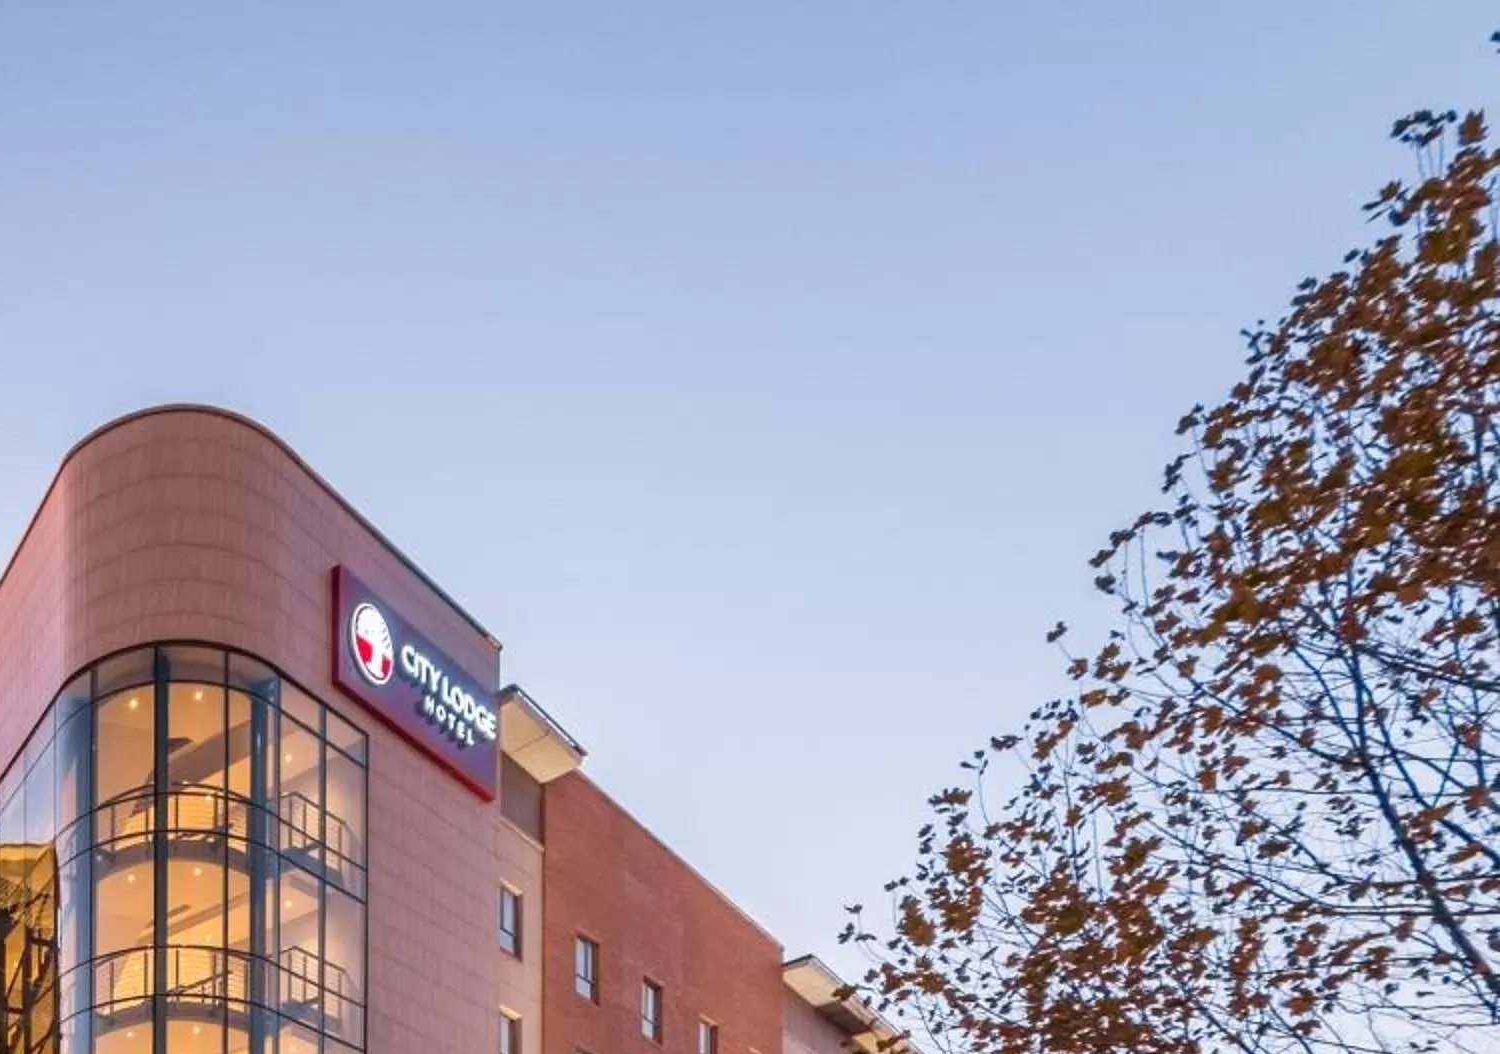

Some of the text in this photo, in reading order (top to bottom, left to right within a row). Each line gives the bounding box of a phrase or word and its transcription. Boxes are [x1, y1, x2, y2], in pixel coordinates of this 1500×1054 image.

[401, 645, 497, 740] CITY LODGE
[424, 696, 475, 745] HOTEL
